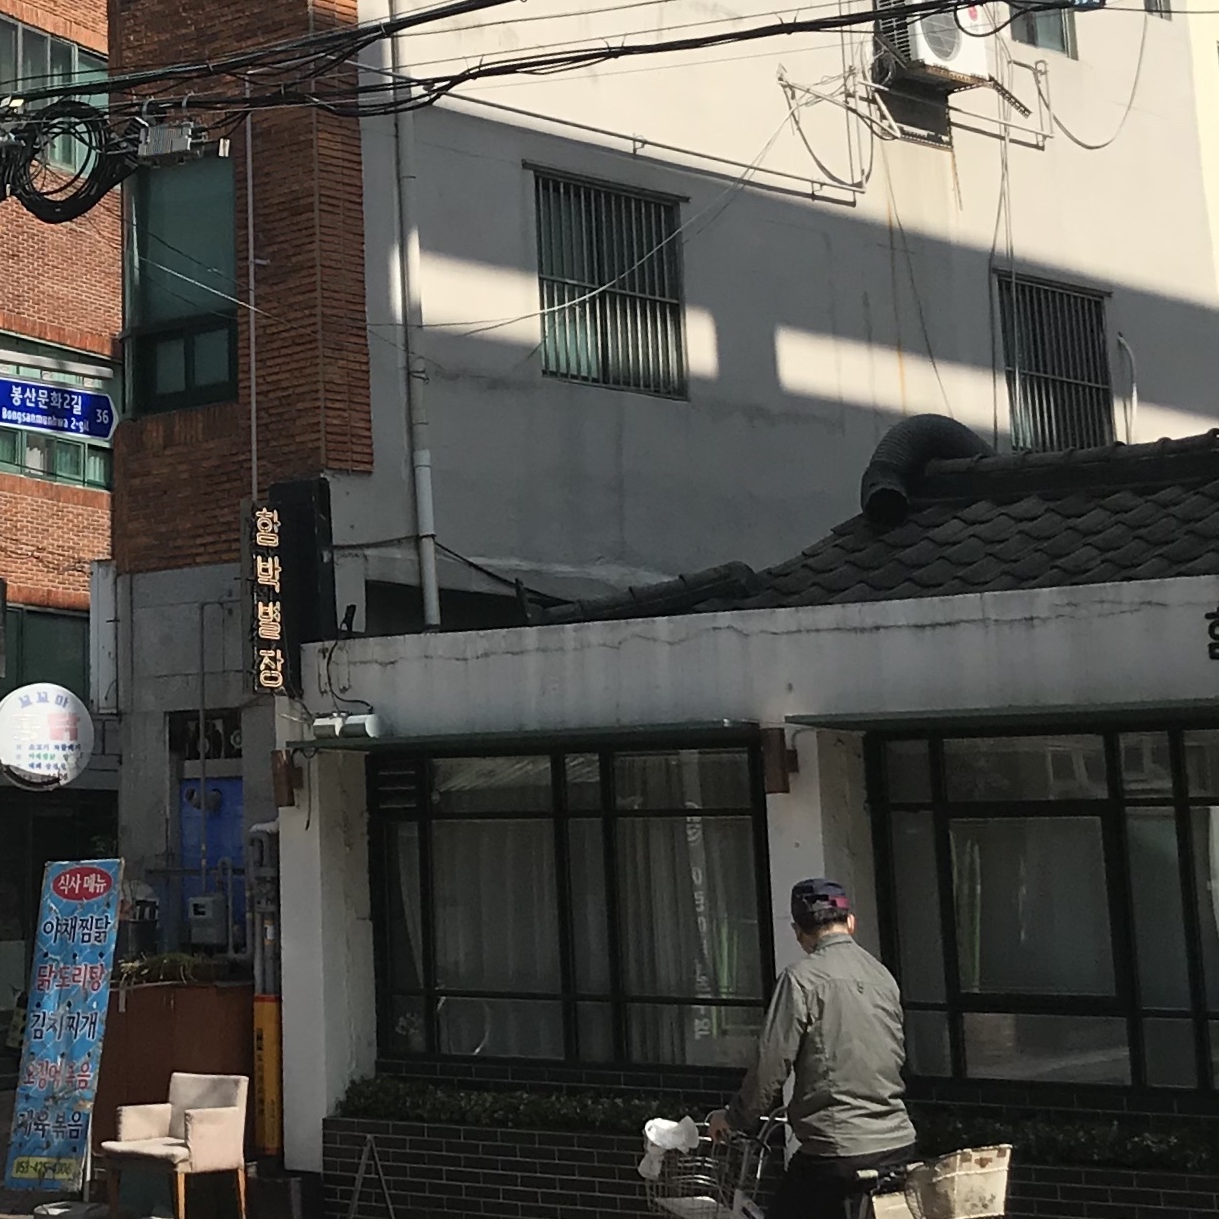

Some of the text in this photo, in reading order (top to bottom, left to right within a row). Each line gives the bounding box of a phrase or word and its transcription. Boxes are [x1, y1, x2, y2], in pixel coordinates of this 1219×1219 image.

[10, 384, 82, 416] 봉산문화2길
[1, 407, 68, 428] Bongsanmunhwa
[95, 409, 109, 424] 36
[58, 872, 107, 894] 식사 메뉴
[43, 915, 111, 944] 야채찜닭
[36, 964, 107, 992] 닭도리탕
